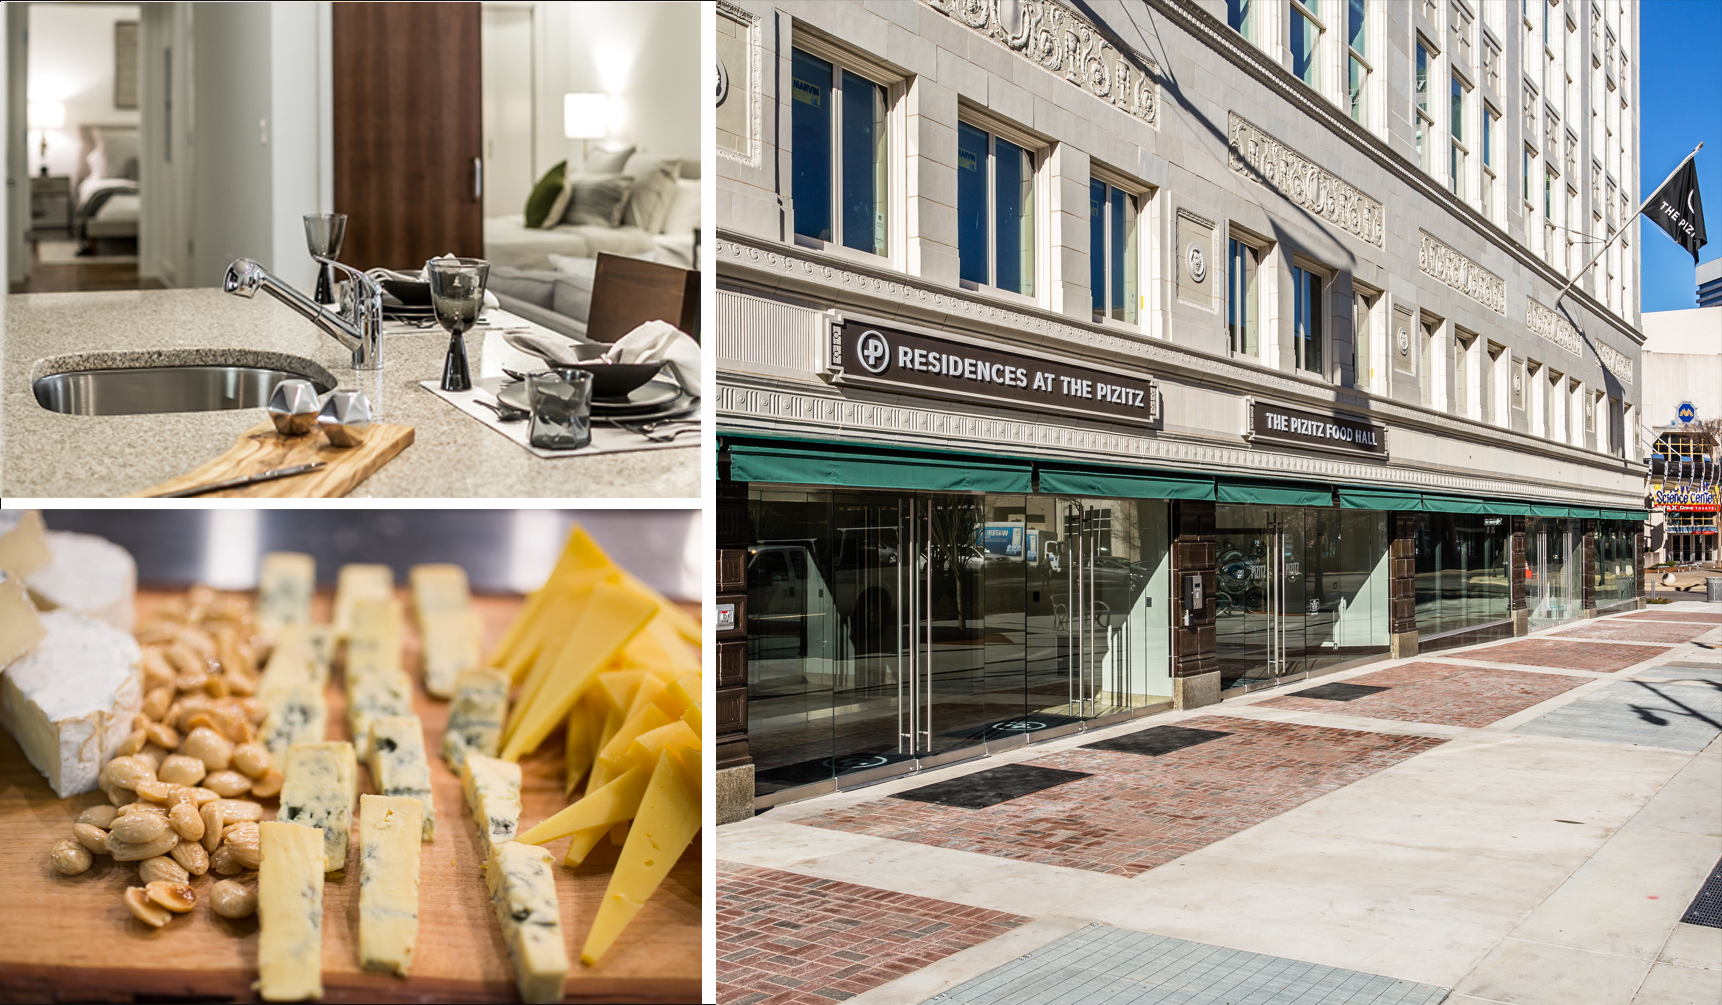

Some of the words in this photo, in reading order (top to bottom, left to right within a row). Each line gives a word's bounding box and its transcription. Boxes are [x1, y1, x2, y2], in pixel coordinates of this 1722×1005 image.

[793, 79, 819, 97] MARVIN
[1660, 201, 1681, 222] THE
[898, 346, 1028, 388] RESIDENCES
[1033, 371, 1055, 392] AT
[1060, 375, 1092, 399] THE
[1097, 382, 1145, 408] PIZITZ
[1265, 412, 1288, 432] THE
[1290, 417, 1325, 438] PIZITZ
[1326, 423, 1353, 442] FOOD
[1355, 429, 1378, 446] HALL
[1656, 490, 1688, 504] Science
